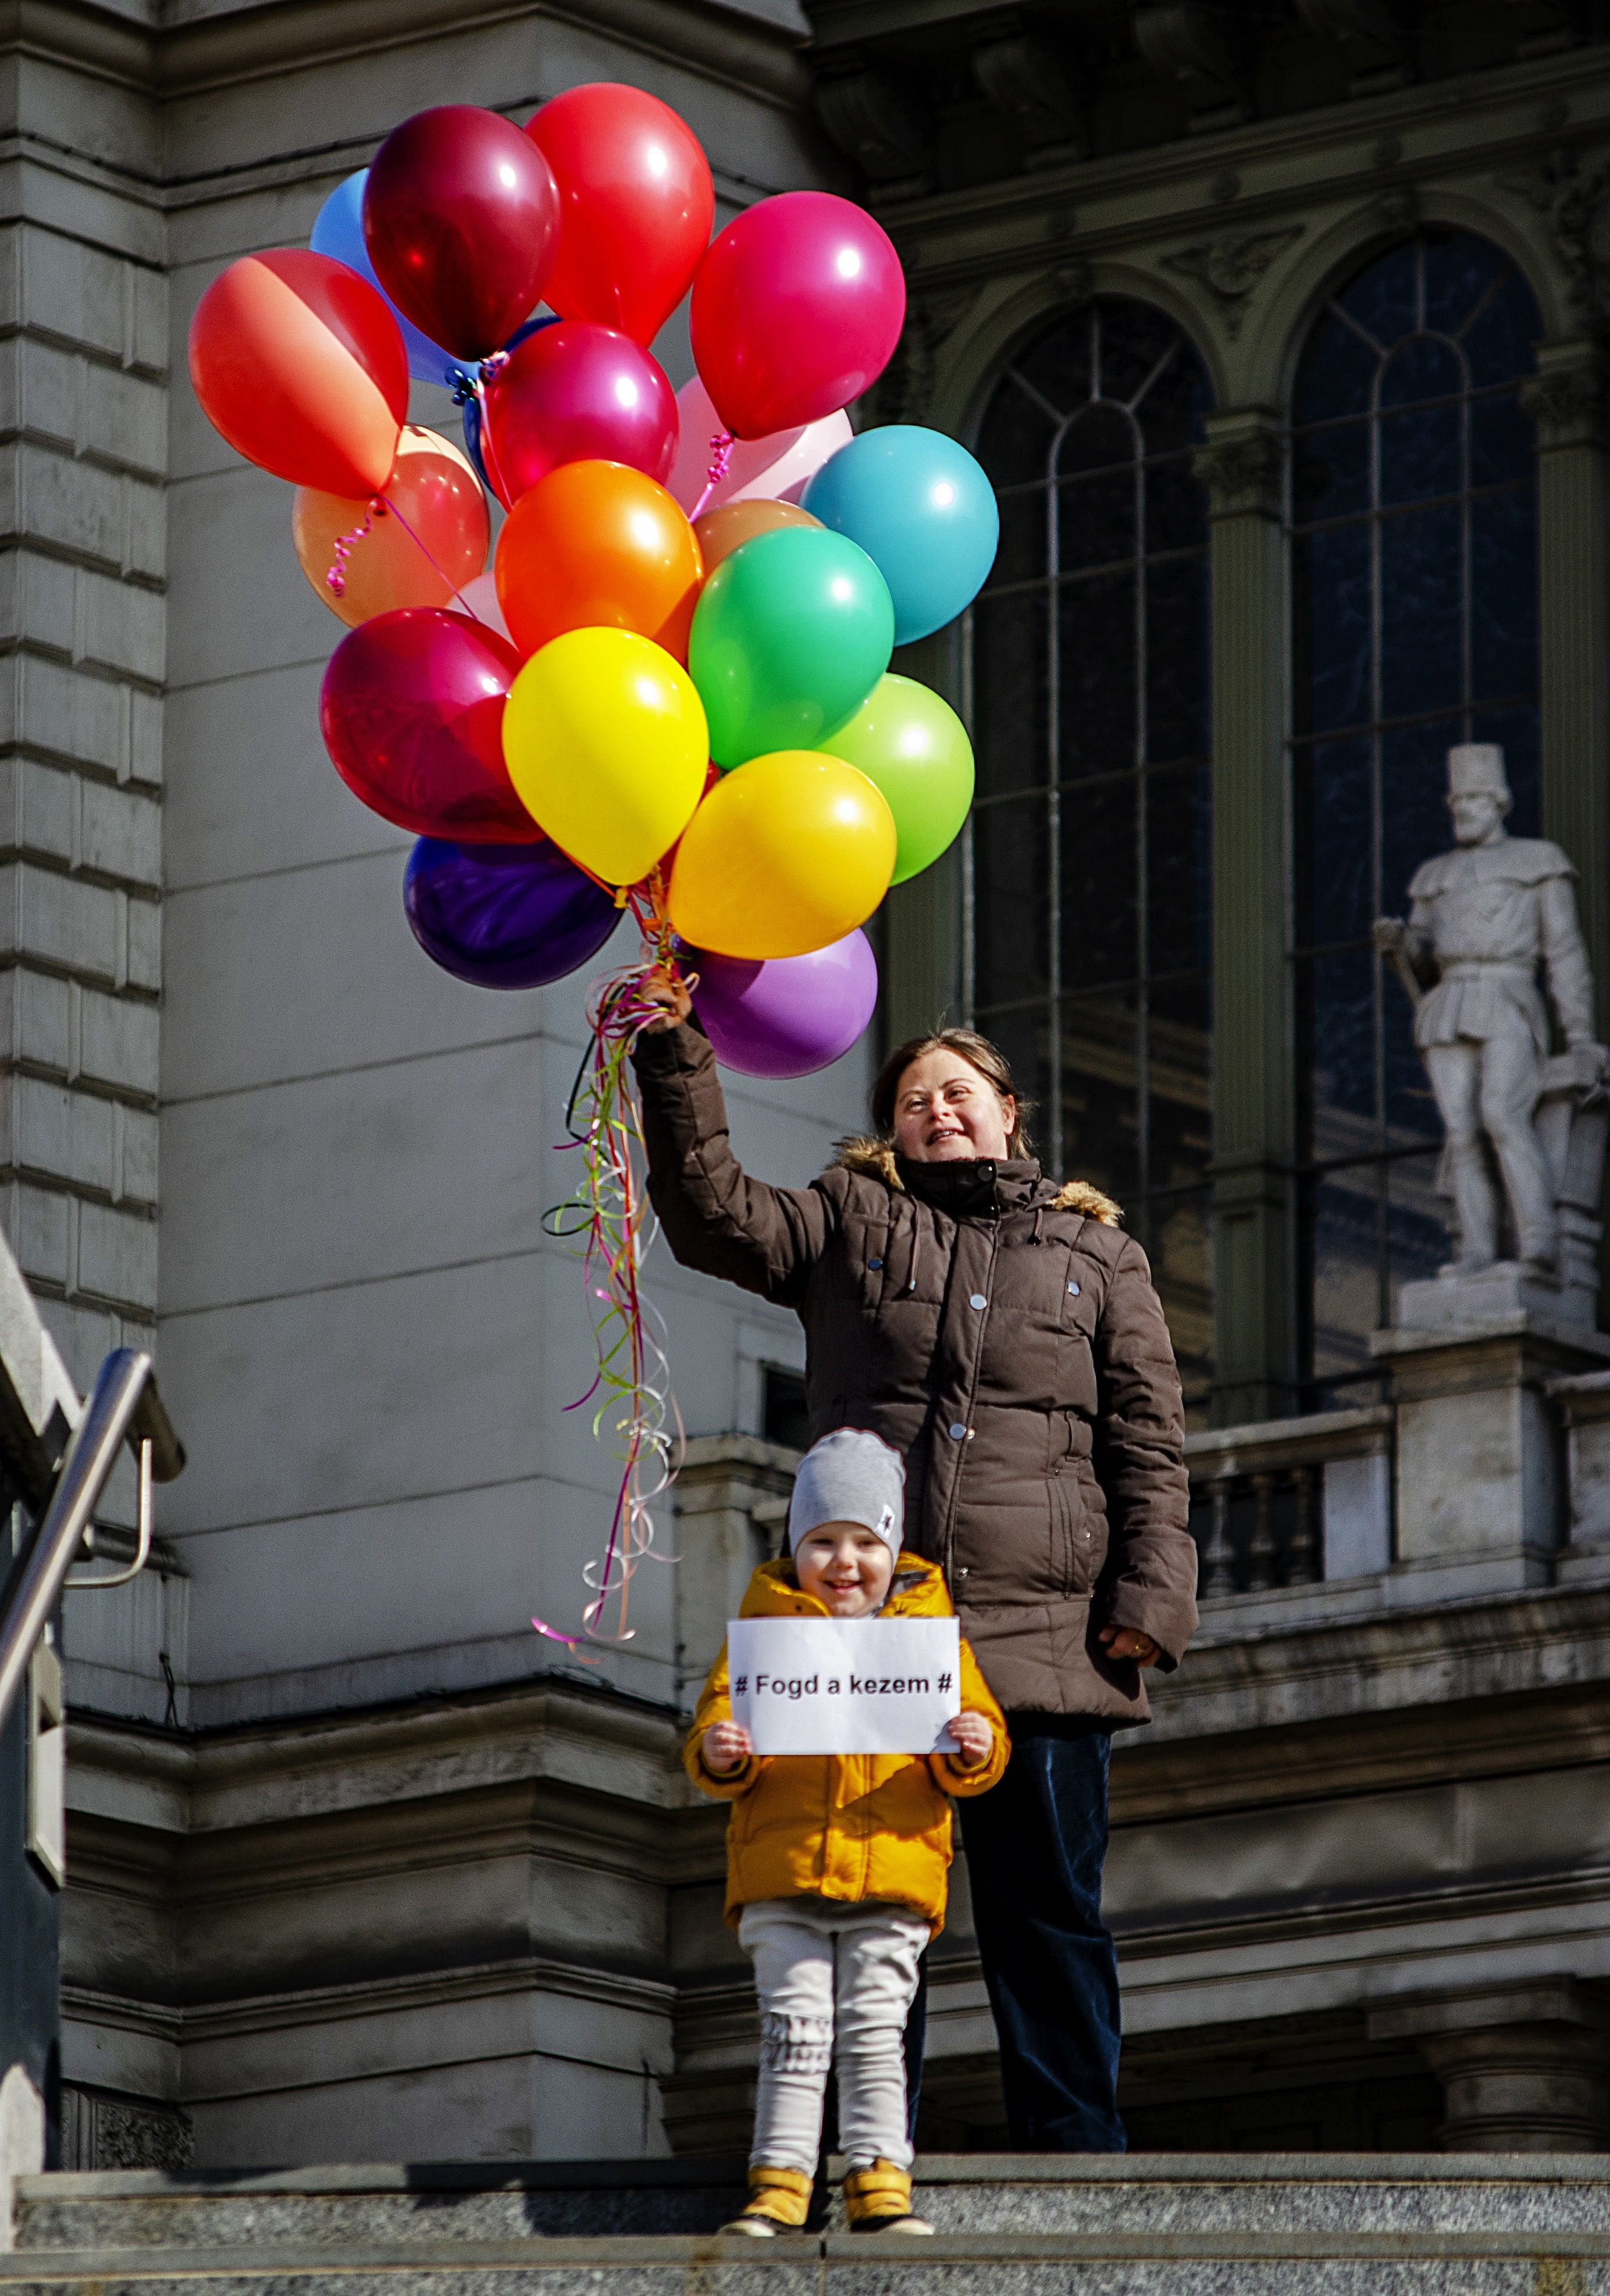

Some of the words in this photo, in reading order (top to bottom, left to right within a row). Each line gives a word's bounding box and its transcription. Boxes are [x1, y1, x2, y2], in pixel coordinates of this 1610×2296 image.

[734, 1675, 749, 1696] #
[756, 1674, 818, 1700] Fogd
[828, 1679, 841, 1694] a
[849, 1674, 929, 1694] kezem
[938, 1673, 953, 1694] #
